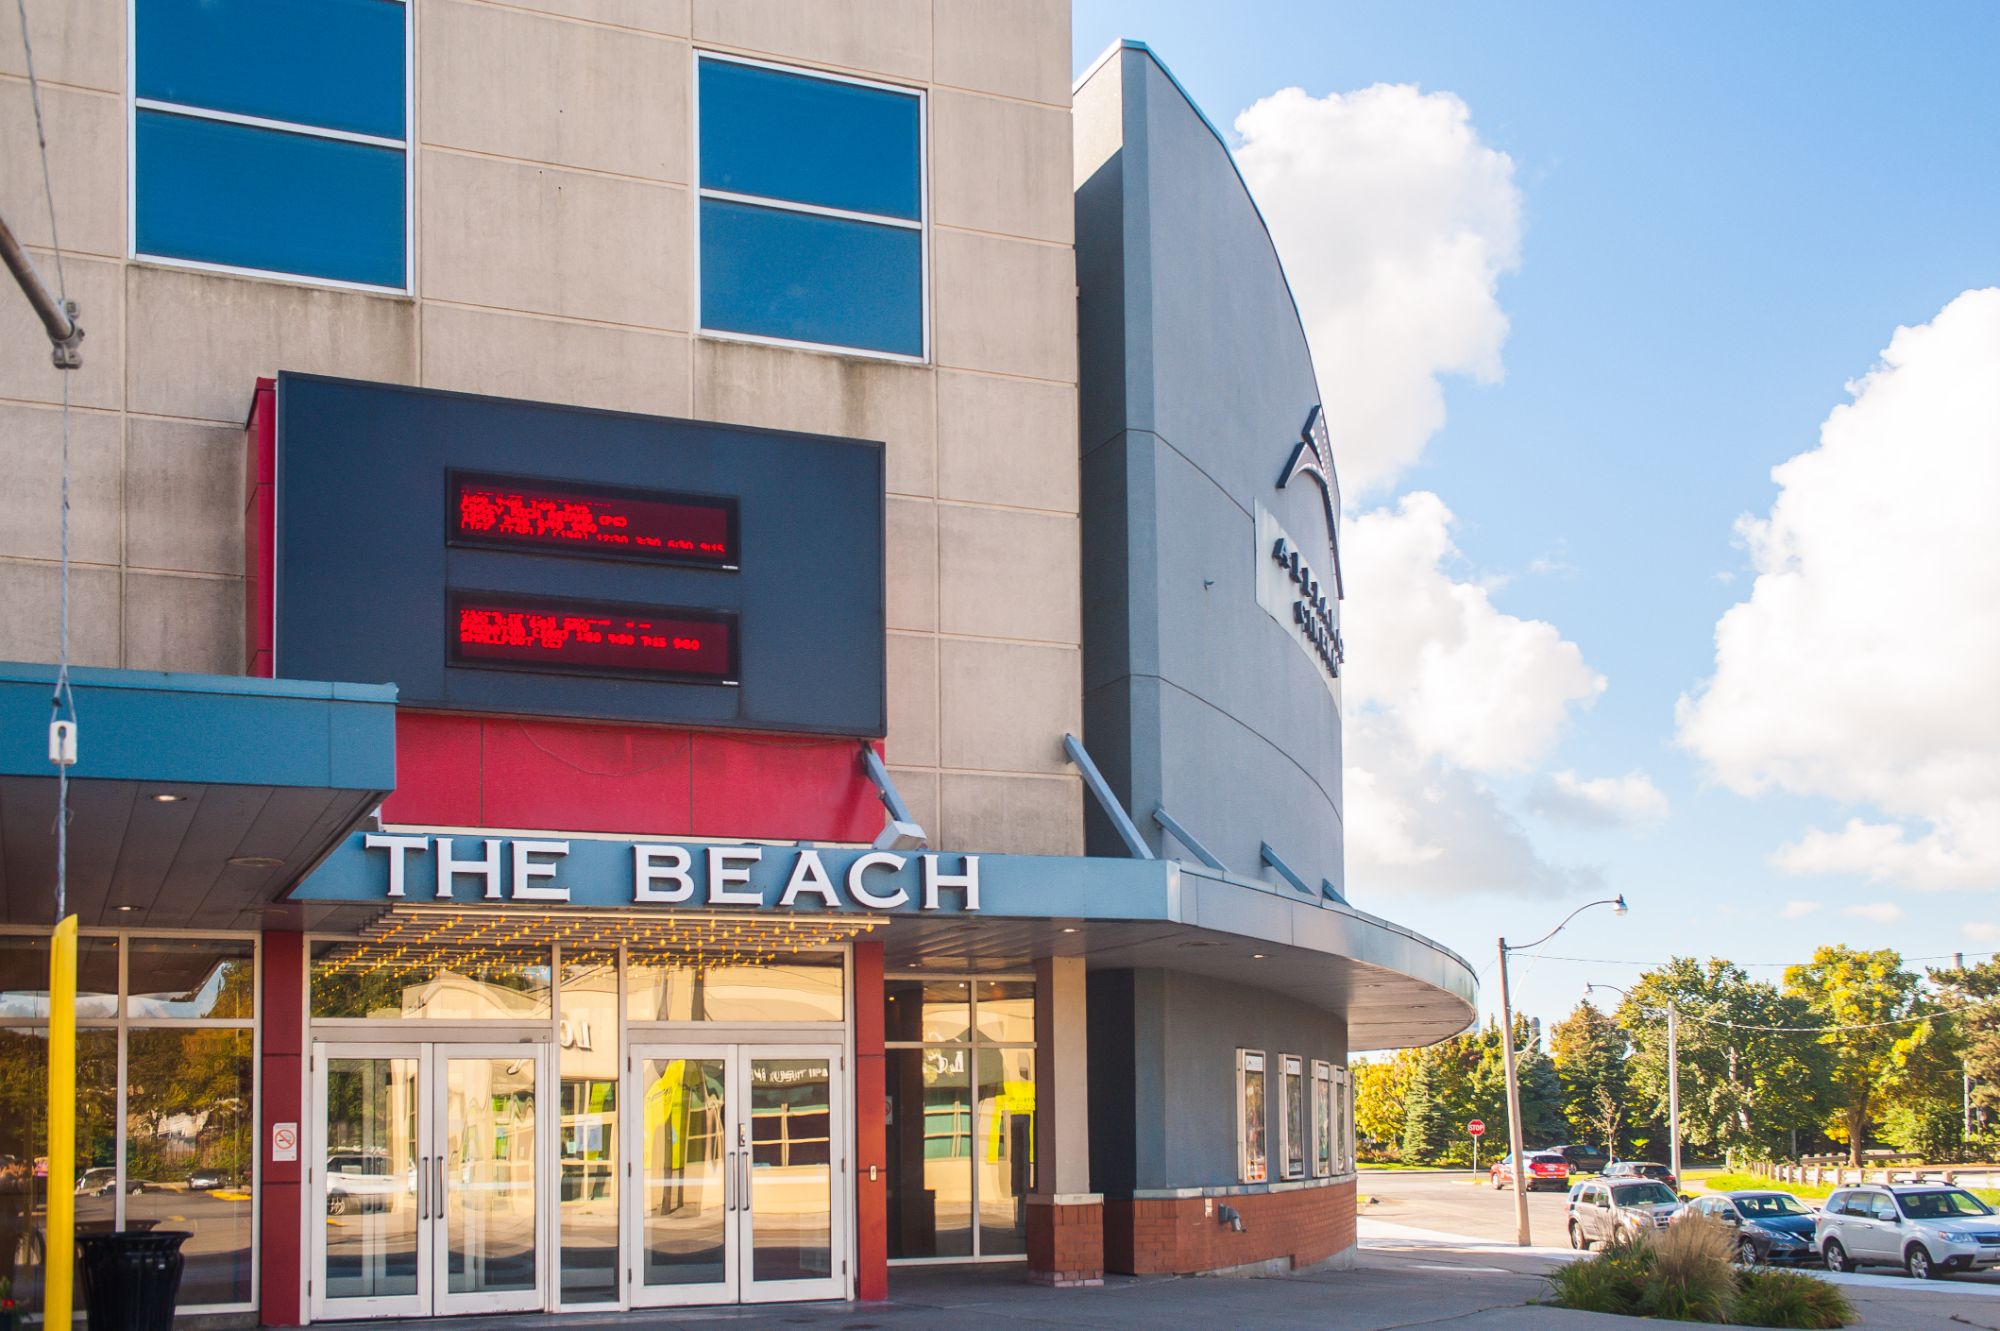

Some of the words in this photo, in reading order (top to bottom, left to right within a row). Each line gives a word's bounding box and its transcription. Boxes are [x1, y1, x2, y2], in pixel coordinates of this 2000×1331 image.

[365, 833, 570, 902] THE
[632, 844, 980, 911] BEACH
[1468, 1124, 1484, 1132] STOP
